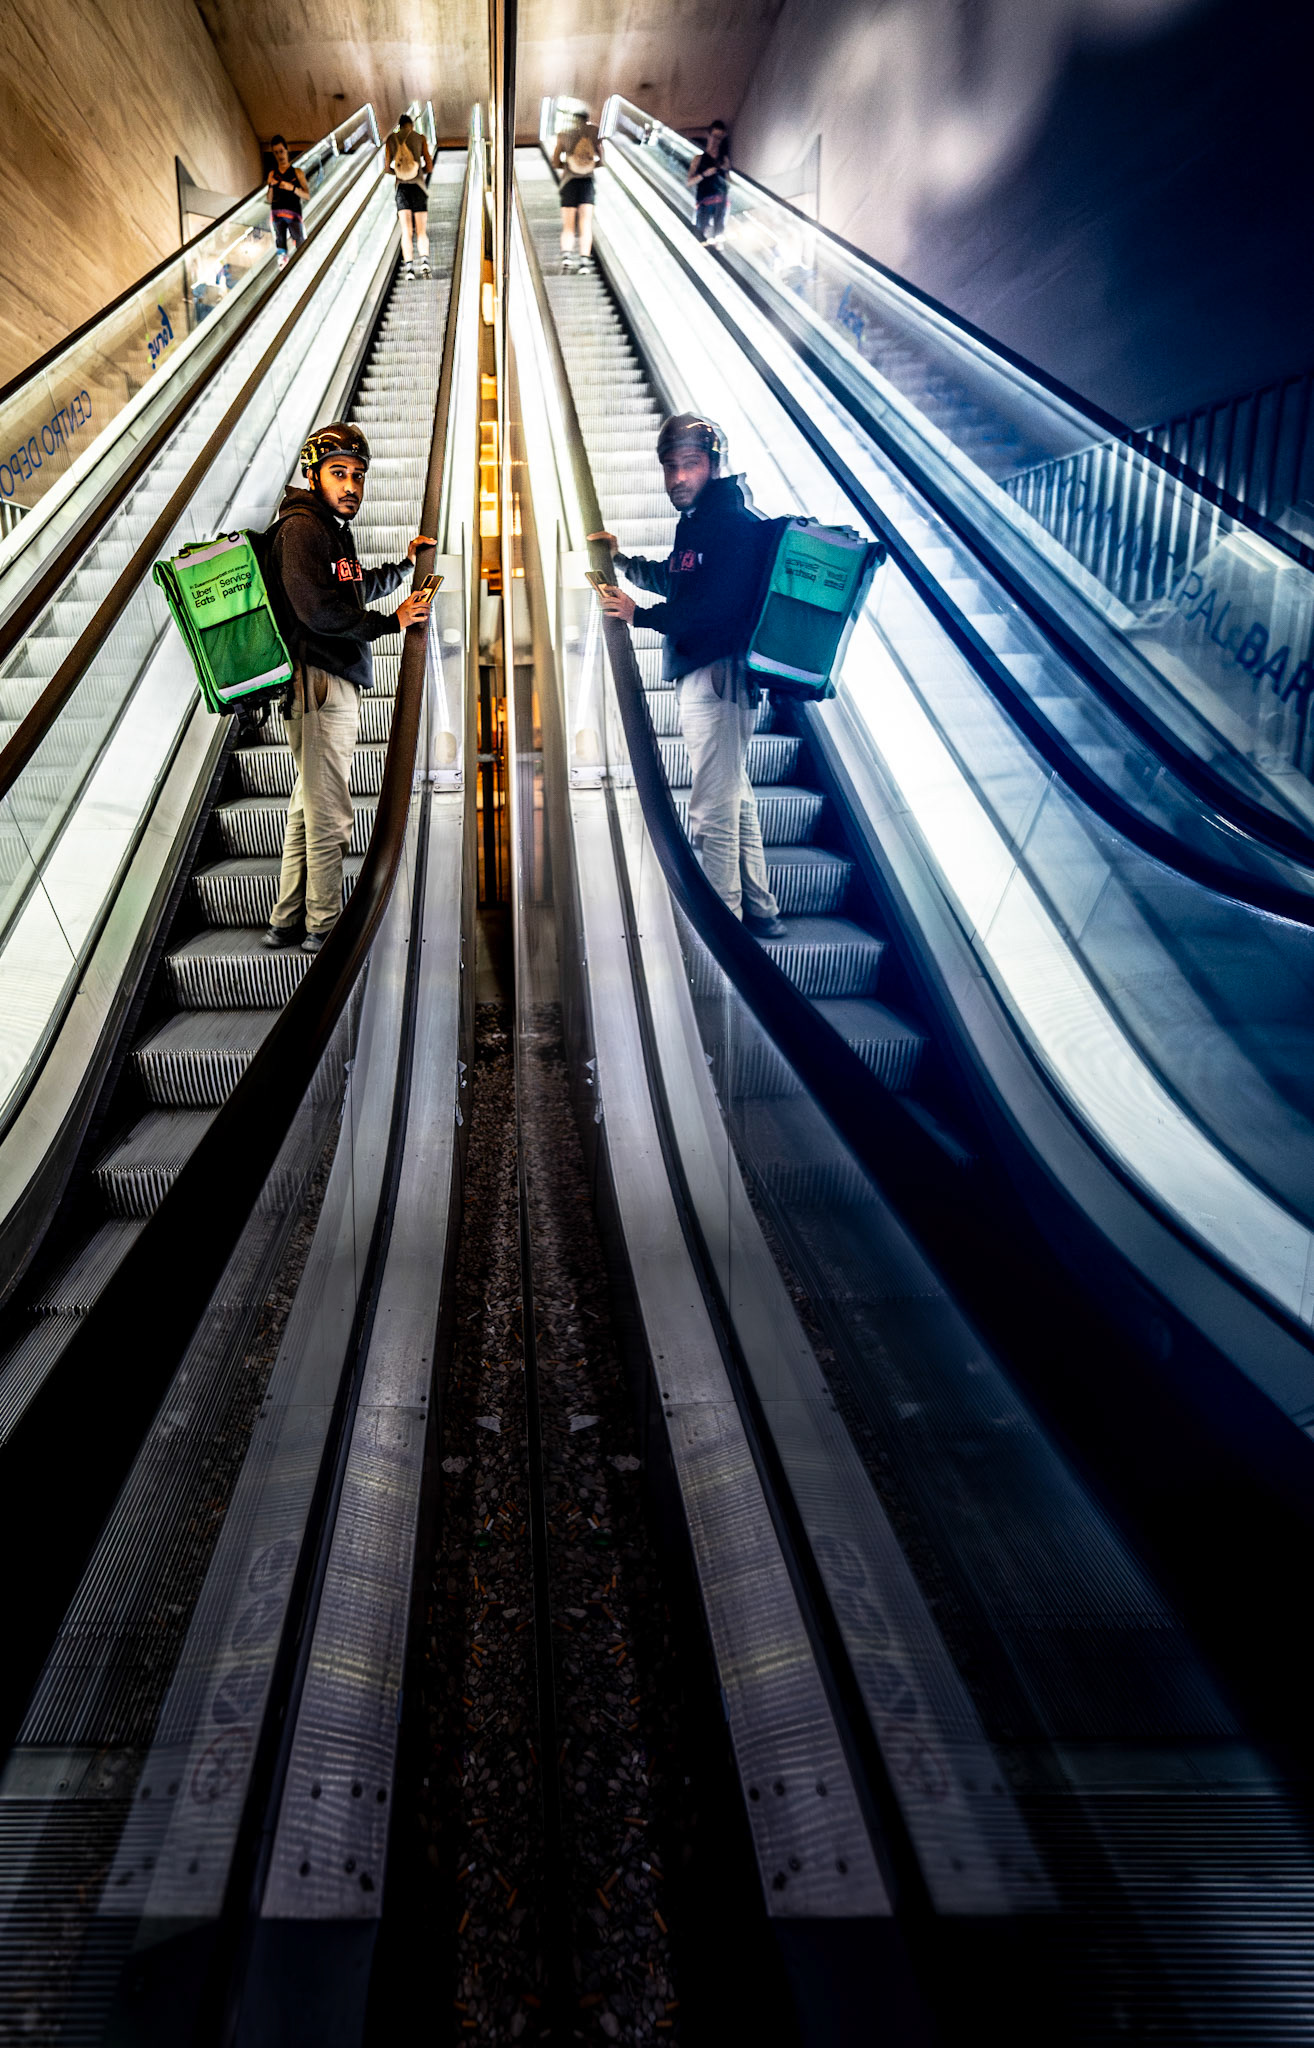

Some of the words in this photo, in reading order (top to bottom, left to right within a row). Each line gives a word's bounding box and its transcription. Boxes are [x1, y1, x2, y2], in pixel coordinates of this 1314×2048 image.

[219, 571, 252, 588] Service
[191, 586, 212, 600] Uber
[194, 595, 216, 609] Eats
